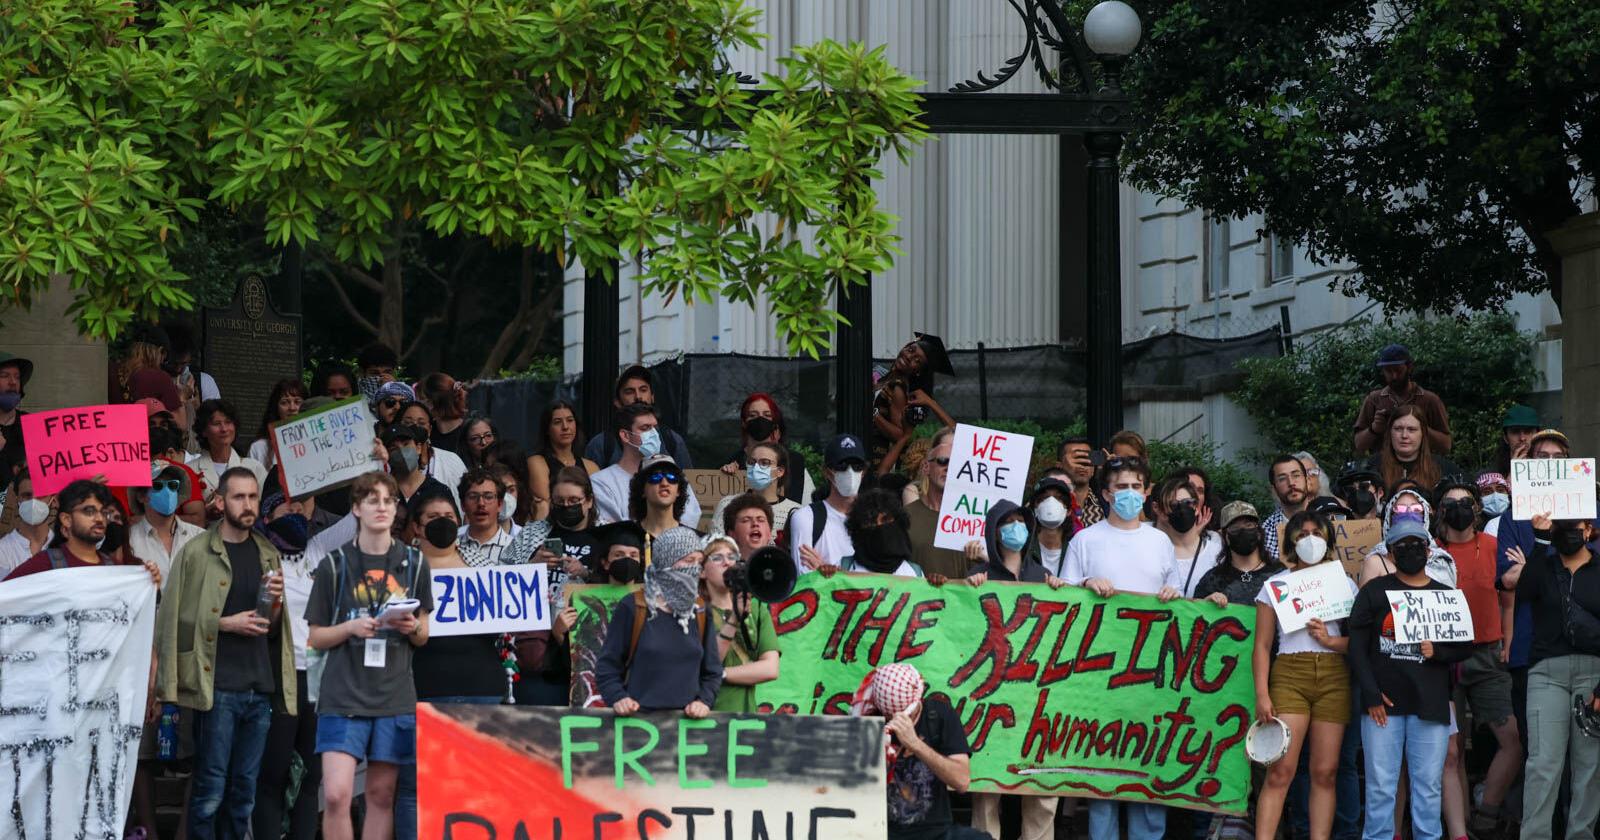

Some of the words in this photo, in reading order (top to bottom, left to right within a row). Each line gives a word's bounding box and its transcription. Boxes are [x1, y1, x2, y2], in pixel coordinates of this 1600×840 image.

[209, 319, 251, 331] UNIVERSITY
[254, 321, 264, 332] OF
[266, 322, 297, 335] GEORGIA
[44, 411, 107, 437] FREE
[281, 422, 309, 445] FROM
[307, 416, 326, 435] THE
[328, 406, 363, 429] RIVER
[289, 443, 306, 458] TO
[311, 434, 333, 453] THE
[333, 428, 357, 450] SEA
[972, 432, 1008, 462] WE
[38, 441, 149, 477] PALESTINE
[1514, 459, 1576, 482] PEOPLE
[956, 460, 1011, 489] ARE
[433, 570, 544, 623] ZIONISM
[1403, 591, 1424, 609] By
[1431, 591, 1458, 605] The
[1406, 606, 1461, 624] Millions
[822, 587, 945, 667] THE
[947, 592, 1252, 701] KILLING
[1434, 623, 1469, 640] Return
[559, 715, 768, 790] FREE
[1020, 688, 1251, 798] humanity?
